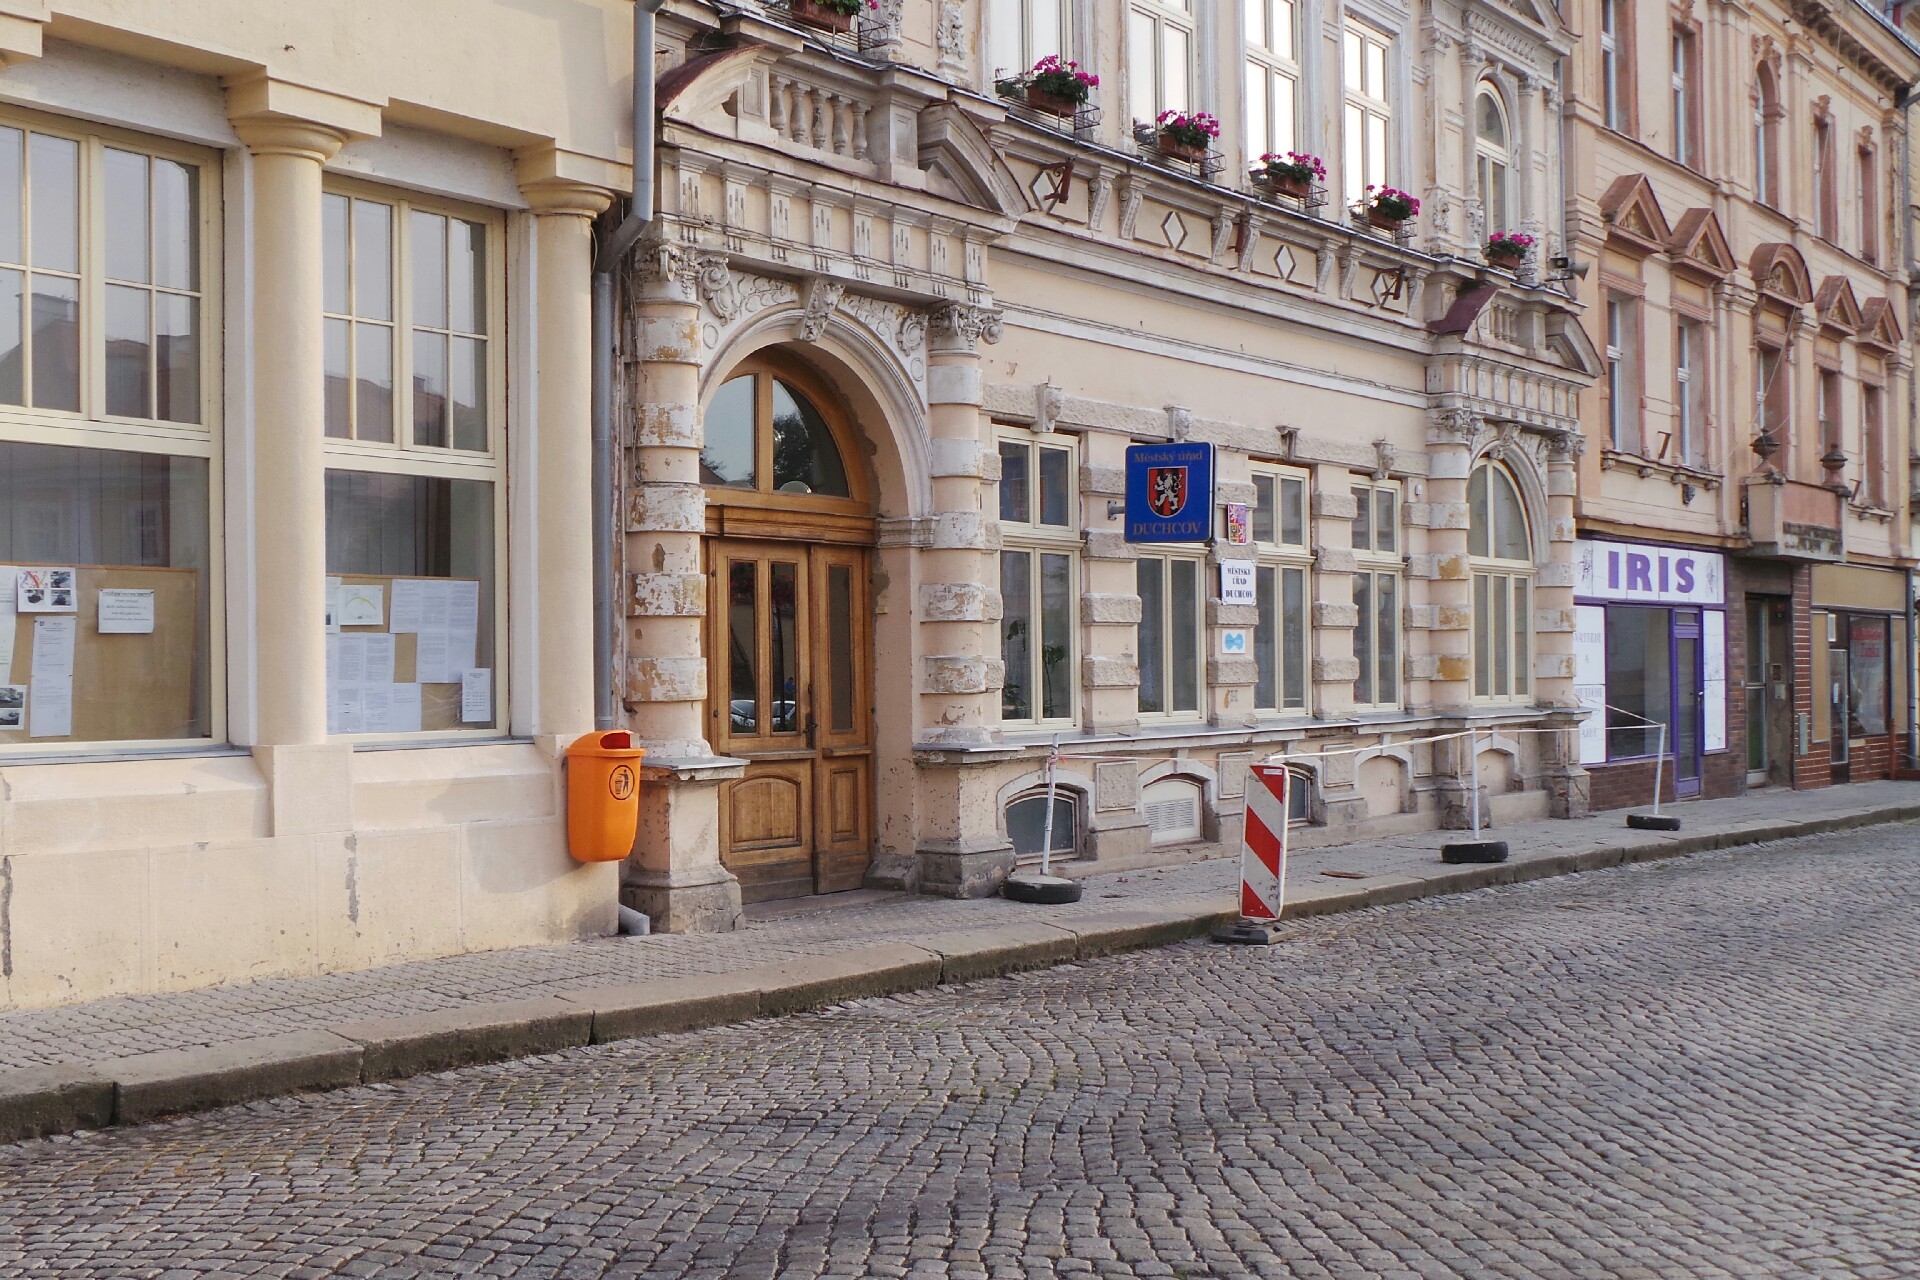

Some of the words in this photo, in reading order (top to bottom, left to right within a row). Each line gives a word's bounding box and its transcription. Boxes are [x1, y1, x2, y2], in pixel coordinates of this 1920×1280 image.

[1134, 451, 1175, 463] Městský
[1178, 450, 1203, 461] úřad
[1133, 521, 1201, 536] DUCHCOV
[1608, 550, 1695, 593] IRIS
[1225, 589, 1253, 598] DUCHCOV
